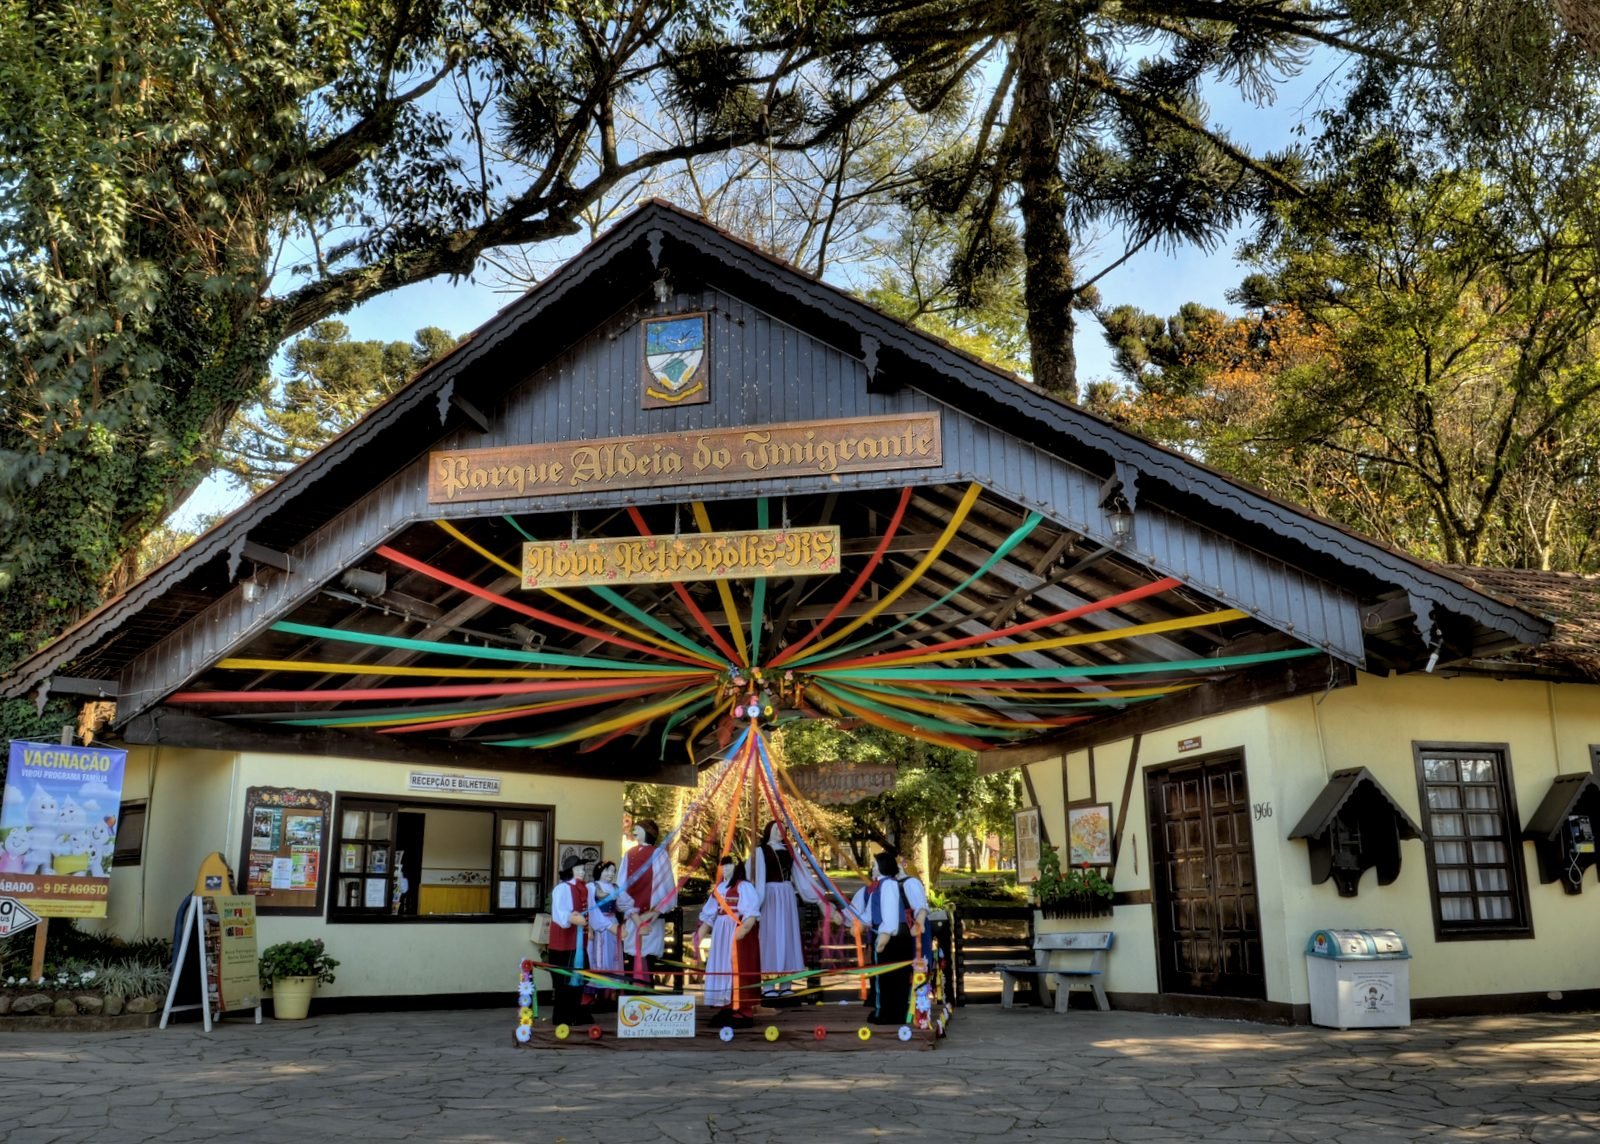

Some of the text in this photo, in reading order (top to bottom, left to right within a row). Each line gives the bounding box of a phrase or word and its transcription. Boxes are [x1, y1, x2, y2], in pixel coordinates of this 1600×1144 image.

[438, 422, 933, 499] Parque Aldeia do Imigrante
[527, 545, 606, 578] Nova
[23, 749, 111, 772] VACINAÇÃO
[21, 769, 108, 783] VIROU PROGRAMA FAMÍLIA
[411, 775, 498, 790] RECEPÇÃO E BILHETERIA
[1253, 801, 1272, 821] 1966
[0, 879, 34, 893] ÁBADO
[43, 883, 51, 893] 9
[53, 884, 68, 893] DE
[69, 884, 108, 895] AGOSTO
[0, 901, 13, 915] O
